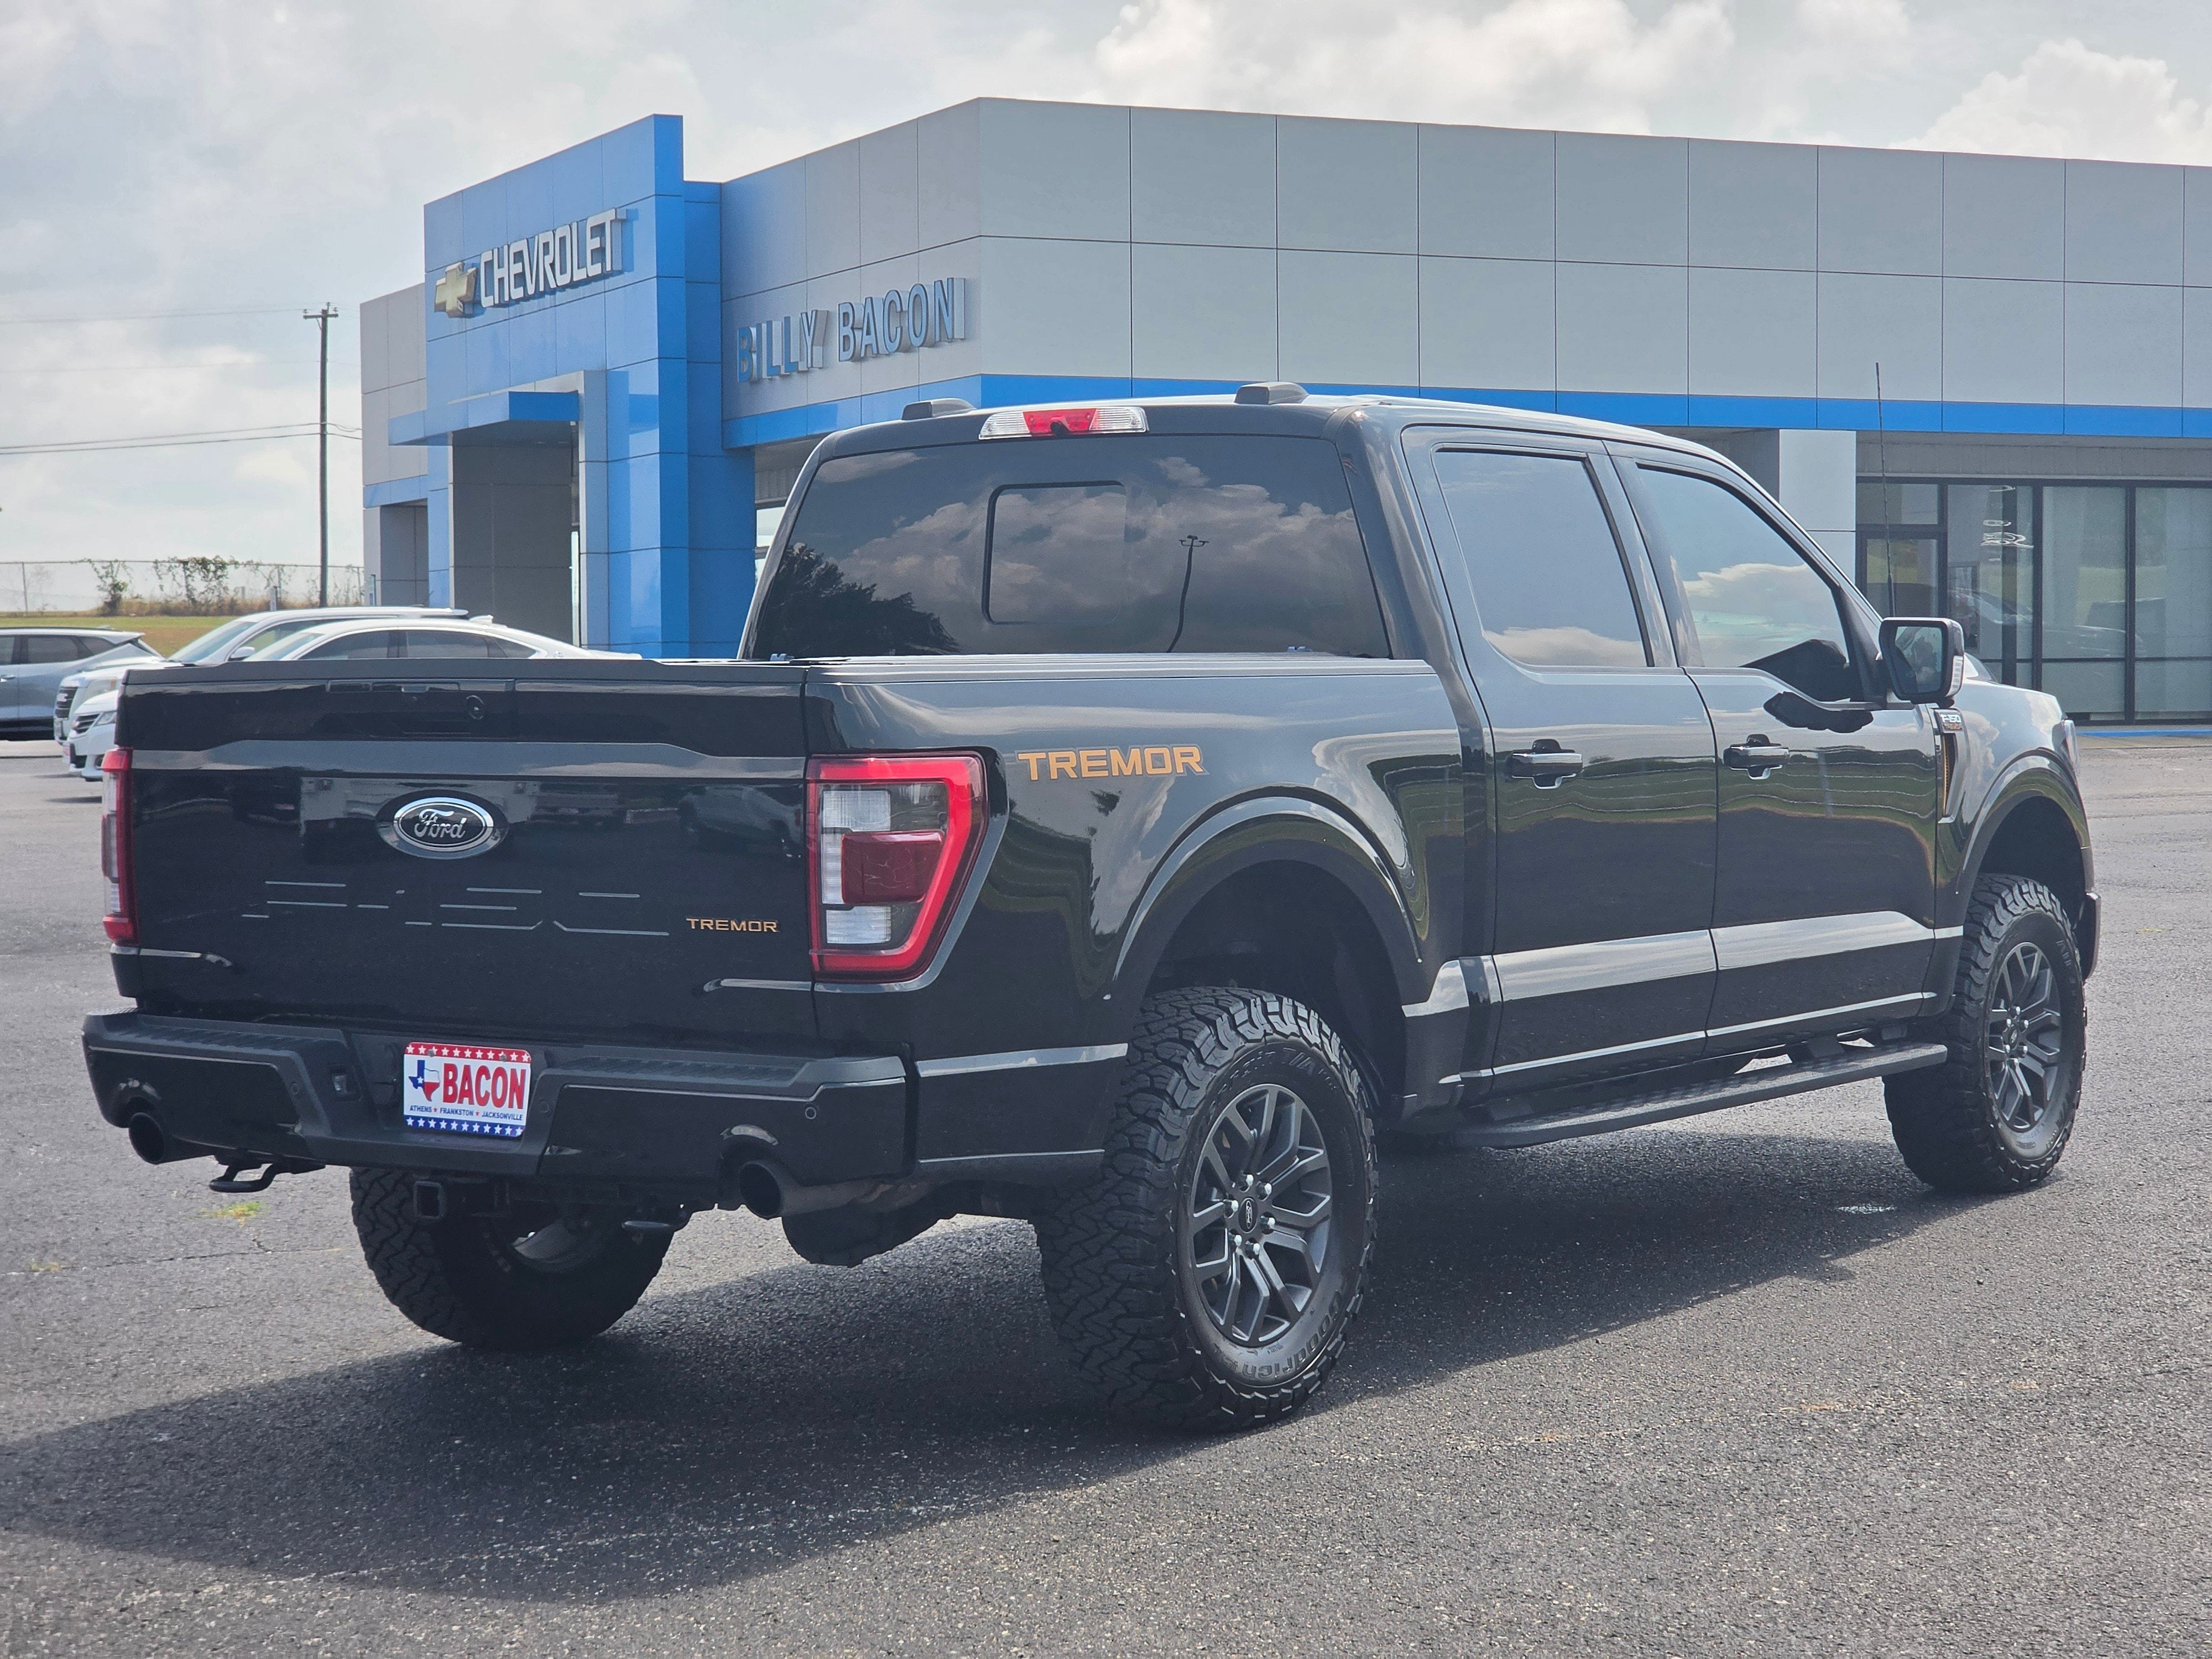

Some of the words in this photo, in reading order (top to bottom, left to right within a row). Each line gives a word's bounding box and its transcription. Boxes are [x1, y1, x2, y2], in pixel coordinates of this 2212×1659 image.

[479, 208, 625, 309] CHEVROLET
[737, 310, 828, 383] BILLY
[838, 277, 966, 362] BACON
[1018, 745, 1204, 781] TREMOR
[414, 808, 467, 839] Ford
[686, 917, 779, 933] TREMOR
[443, 1063, 526, 1109] BACON
[409, 1105, 432, 1113] ATHENS
[440, 1107, 474, 1117] FRANKSTON
[482, 1110, 523, 1121] JACKSONVILLE
